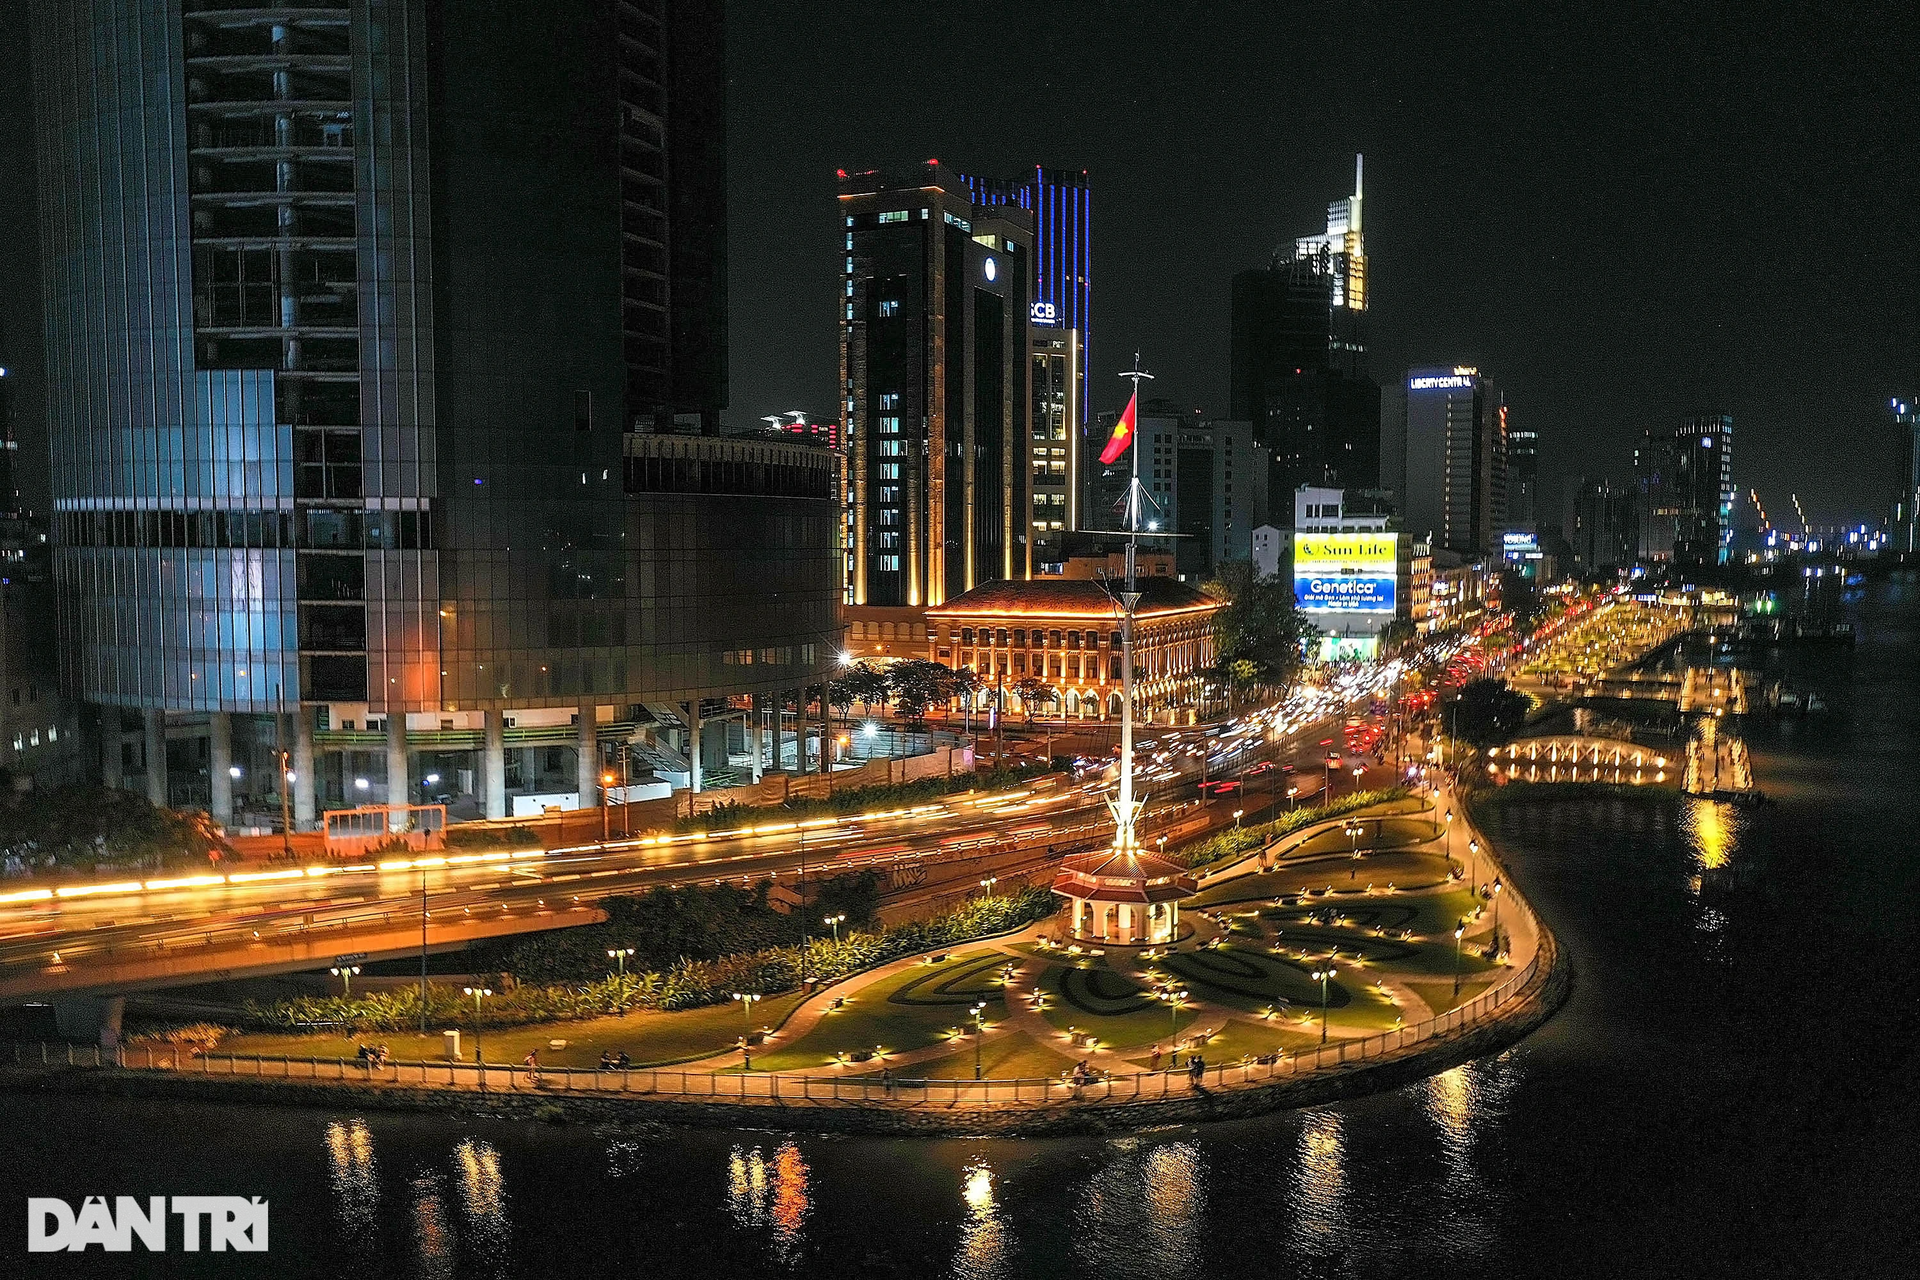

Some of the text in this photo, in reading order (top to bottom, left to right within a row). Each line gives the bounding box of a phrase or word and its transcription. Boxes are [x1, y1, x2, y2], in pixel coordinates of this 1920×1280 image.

[1324, 544, 1387, 555] Sun Life
[1310, 579, 1374, 595] Genetica
